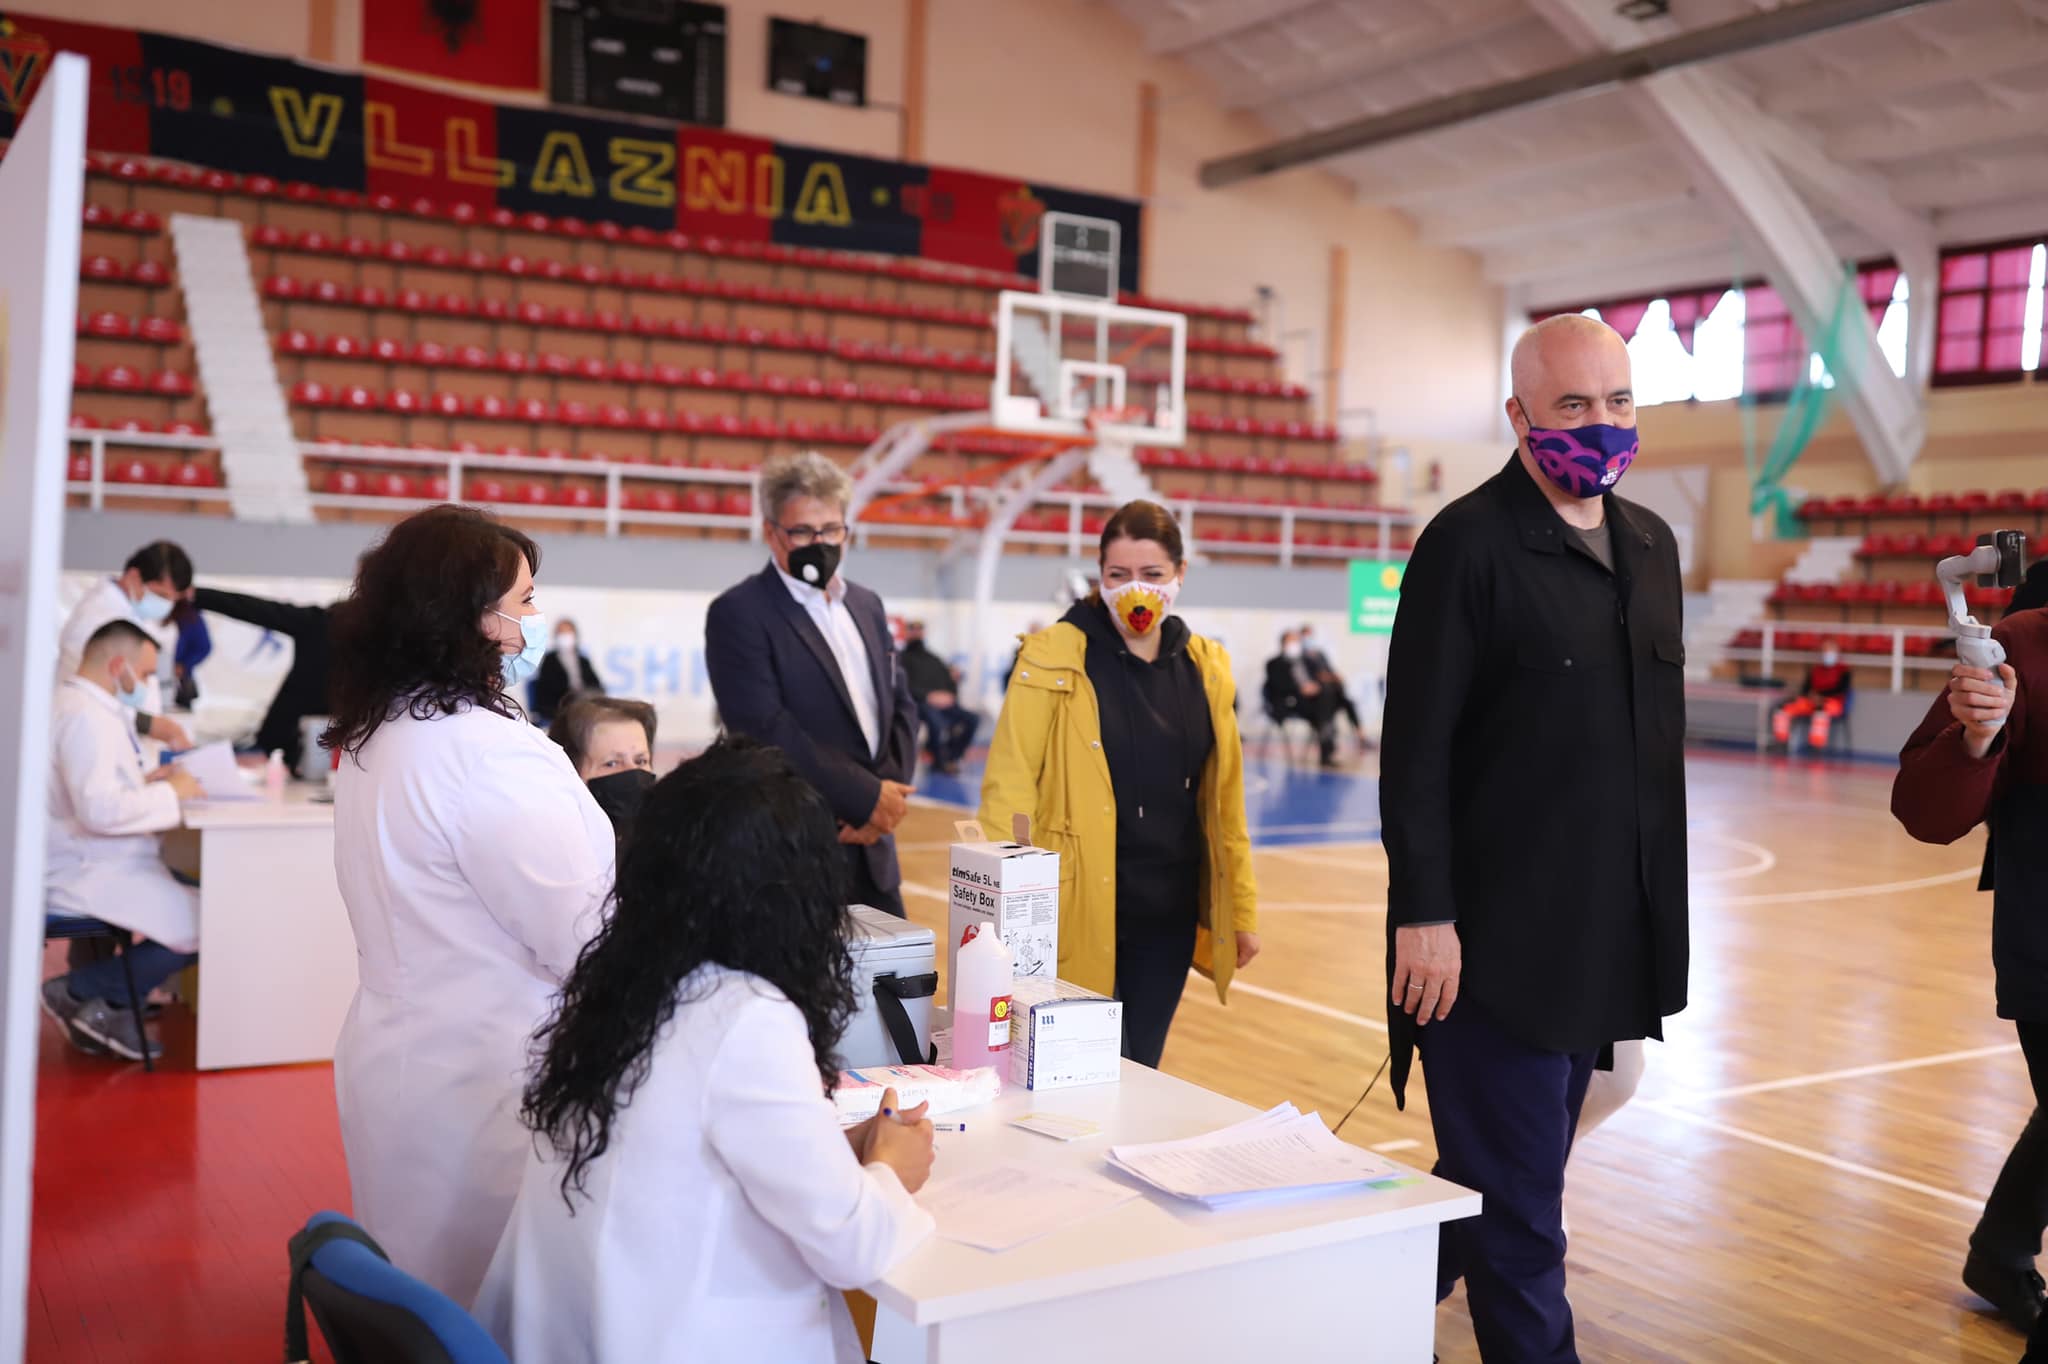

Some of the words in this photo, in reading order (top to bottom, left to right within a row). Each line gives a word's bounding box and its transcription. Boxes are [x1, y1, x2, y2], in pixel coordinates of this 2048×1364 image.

[268, 86, 853, 226] VLLAZNIA
[983, 874, 992, 887] 5L
[953, 884, 977, 906] Safety
[979, 891, 995, 908] Box
